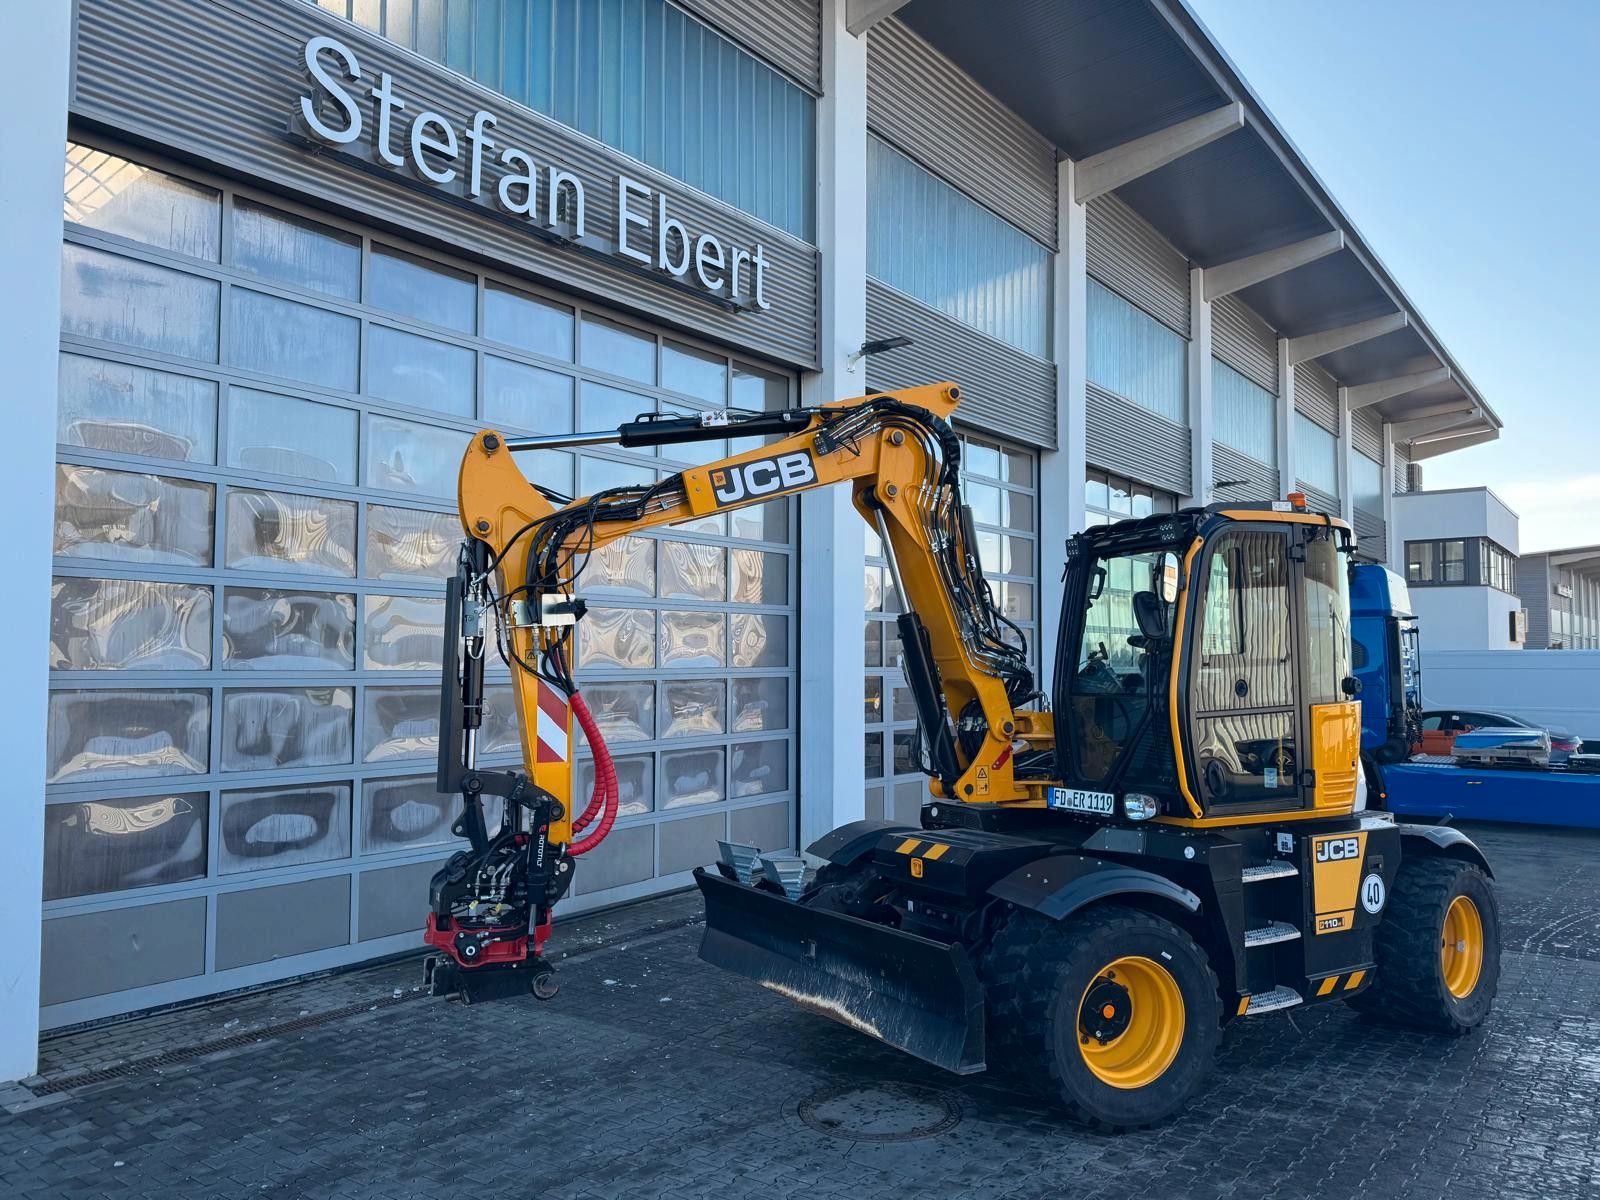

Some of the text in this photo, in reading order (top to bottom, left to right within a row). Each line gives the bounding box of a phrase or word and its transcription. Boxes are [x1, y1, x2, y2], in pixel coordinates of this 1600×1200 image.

[300, 36, 770, 310] Stefan Ebert
[716, 452, 815, 503] JCB
[1054, 789, 1113, 812] FD ER 1119
[1316, 838, 1359, 862] JCB
[1367, 882, 1380, 906] 40
